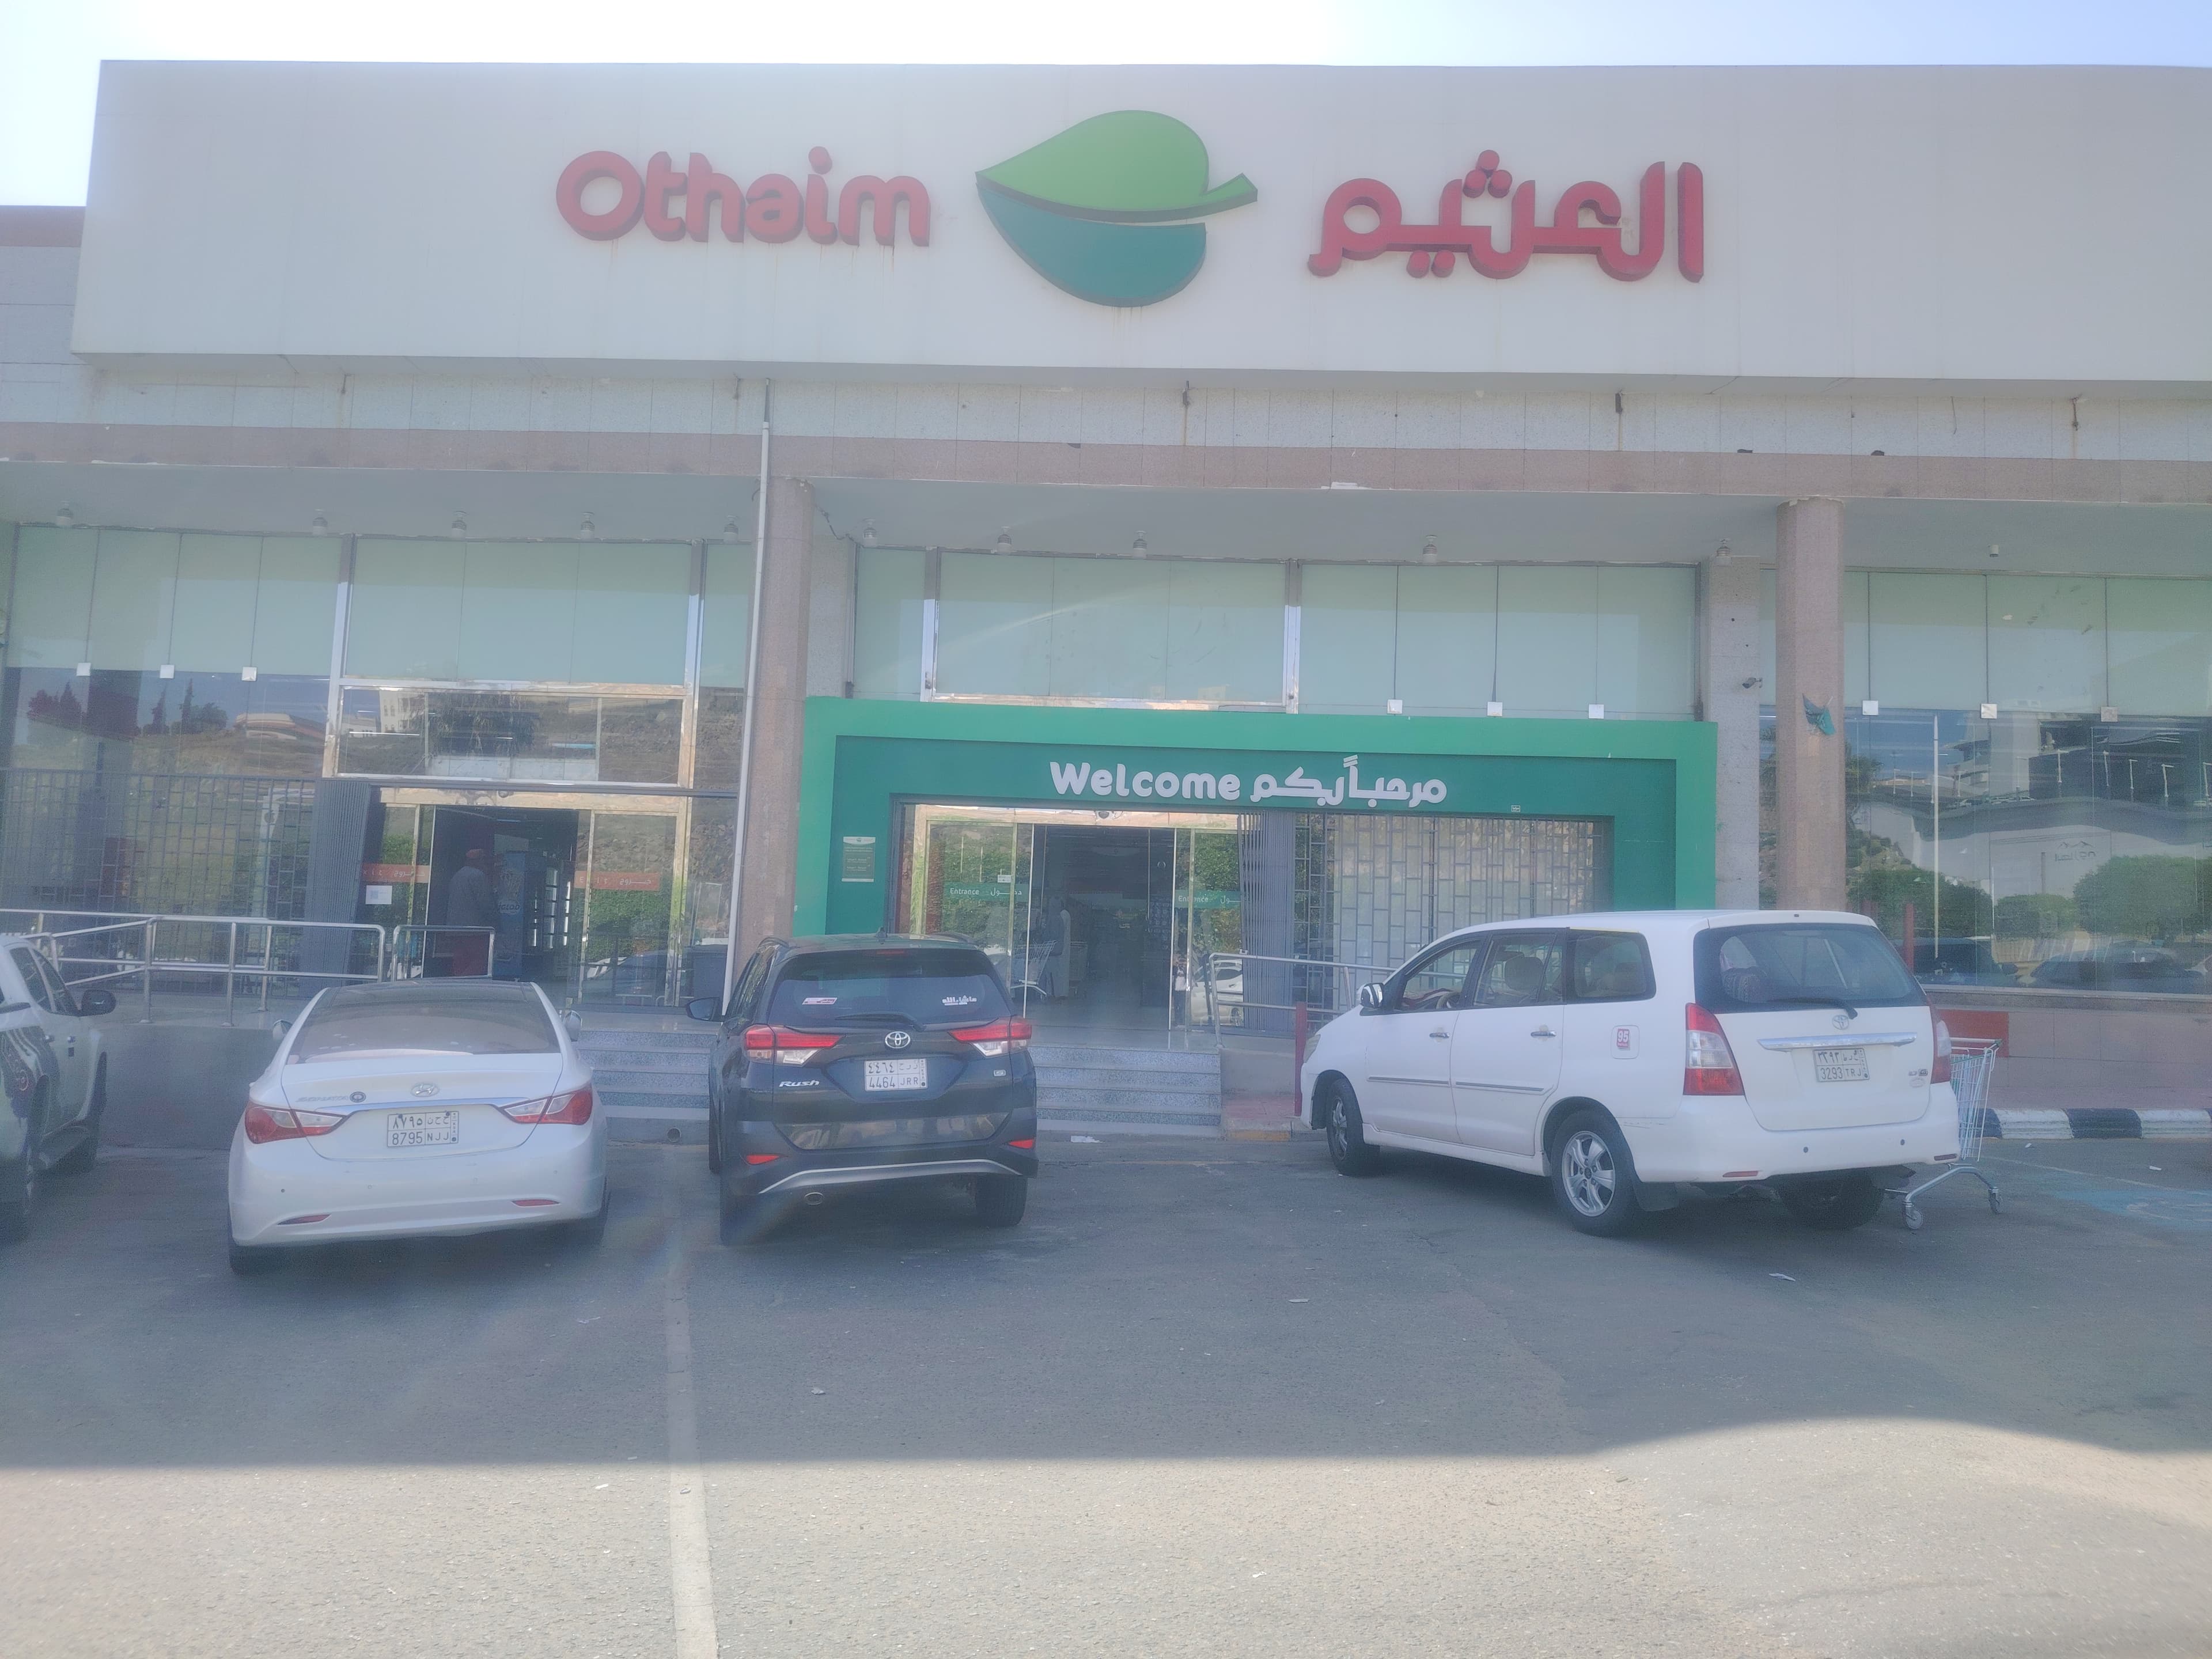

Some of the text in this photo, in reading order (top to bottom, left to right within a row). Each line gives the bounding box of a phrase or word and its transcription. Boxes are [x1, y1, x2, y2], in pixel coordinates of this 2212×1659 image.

[556, 146, 931, 247] Othaim
[1308, 149, 1704, 283] العثيم
[1050, 762, 1240, 800] Welcome
[1249, 766, 1344, 806] بكم
[949, 887, 980, 896] Entrance
[1618, 1030, 1629, 1043] 95
[868, 1062, 895, 1074] ٤٤٦٤
[1820, 1067, 1843, 1080] 3293
[779, 1080, 820, 1088] Rush
[869, 1075, 896, 1088] 4464
[392, 1116, 423, 1130] ٨٧٩٥
[392, 1131, 423, 1145] 8795
